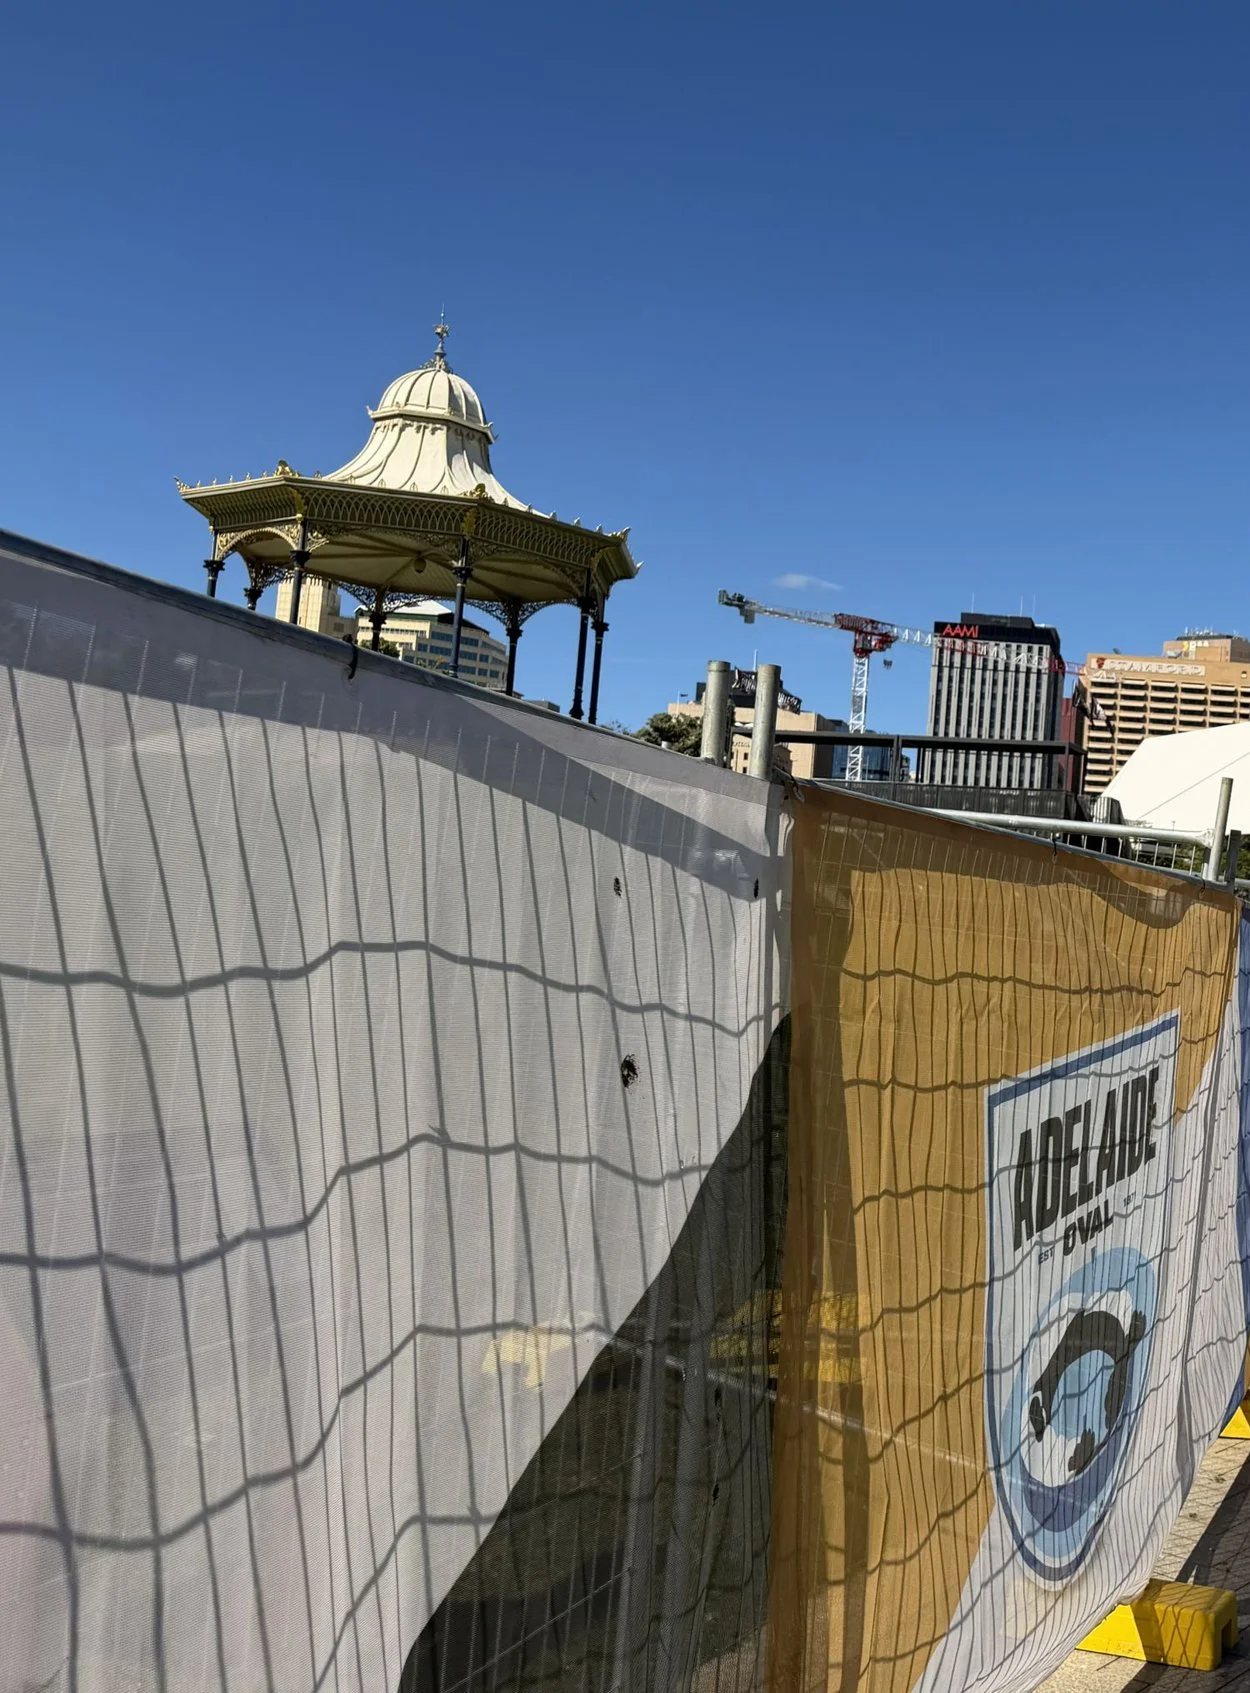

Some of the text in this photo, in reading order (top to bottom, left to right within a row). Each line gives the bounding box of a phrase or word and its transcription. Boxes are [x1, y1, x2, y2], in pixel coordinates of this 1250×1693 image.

[943, 624, 979, 638] AAMI
[1014, 1066, 1159, 1252] ADELAIDE
[1063, 1198, 1114, 1256] OVAL
[1038, 1249, 1055, 1265] EST
